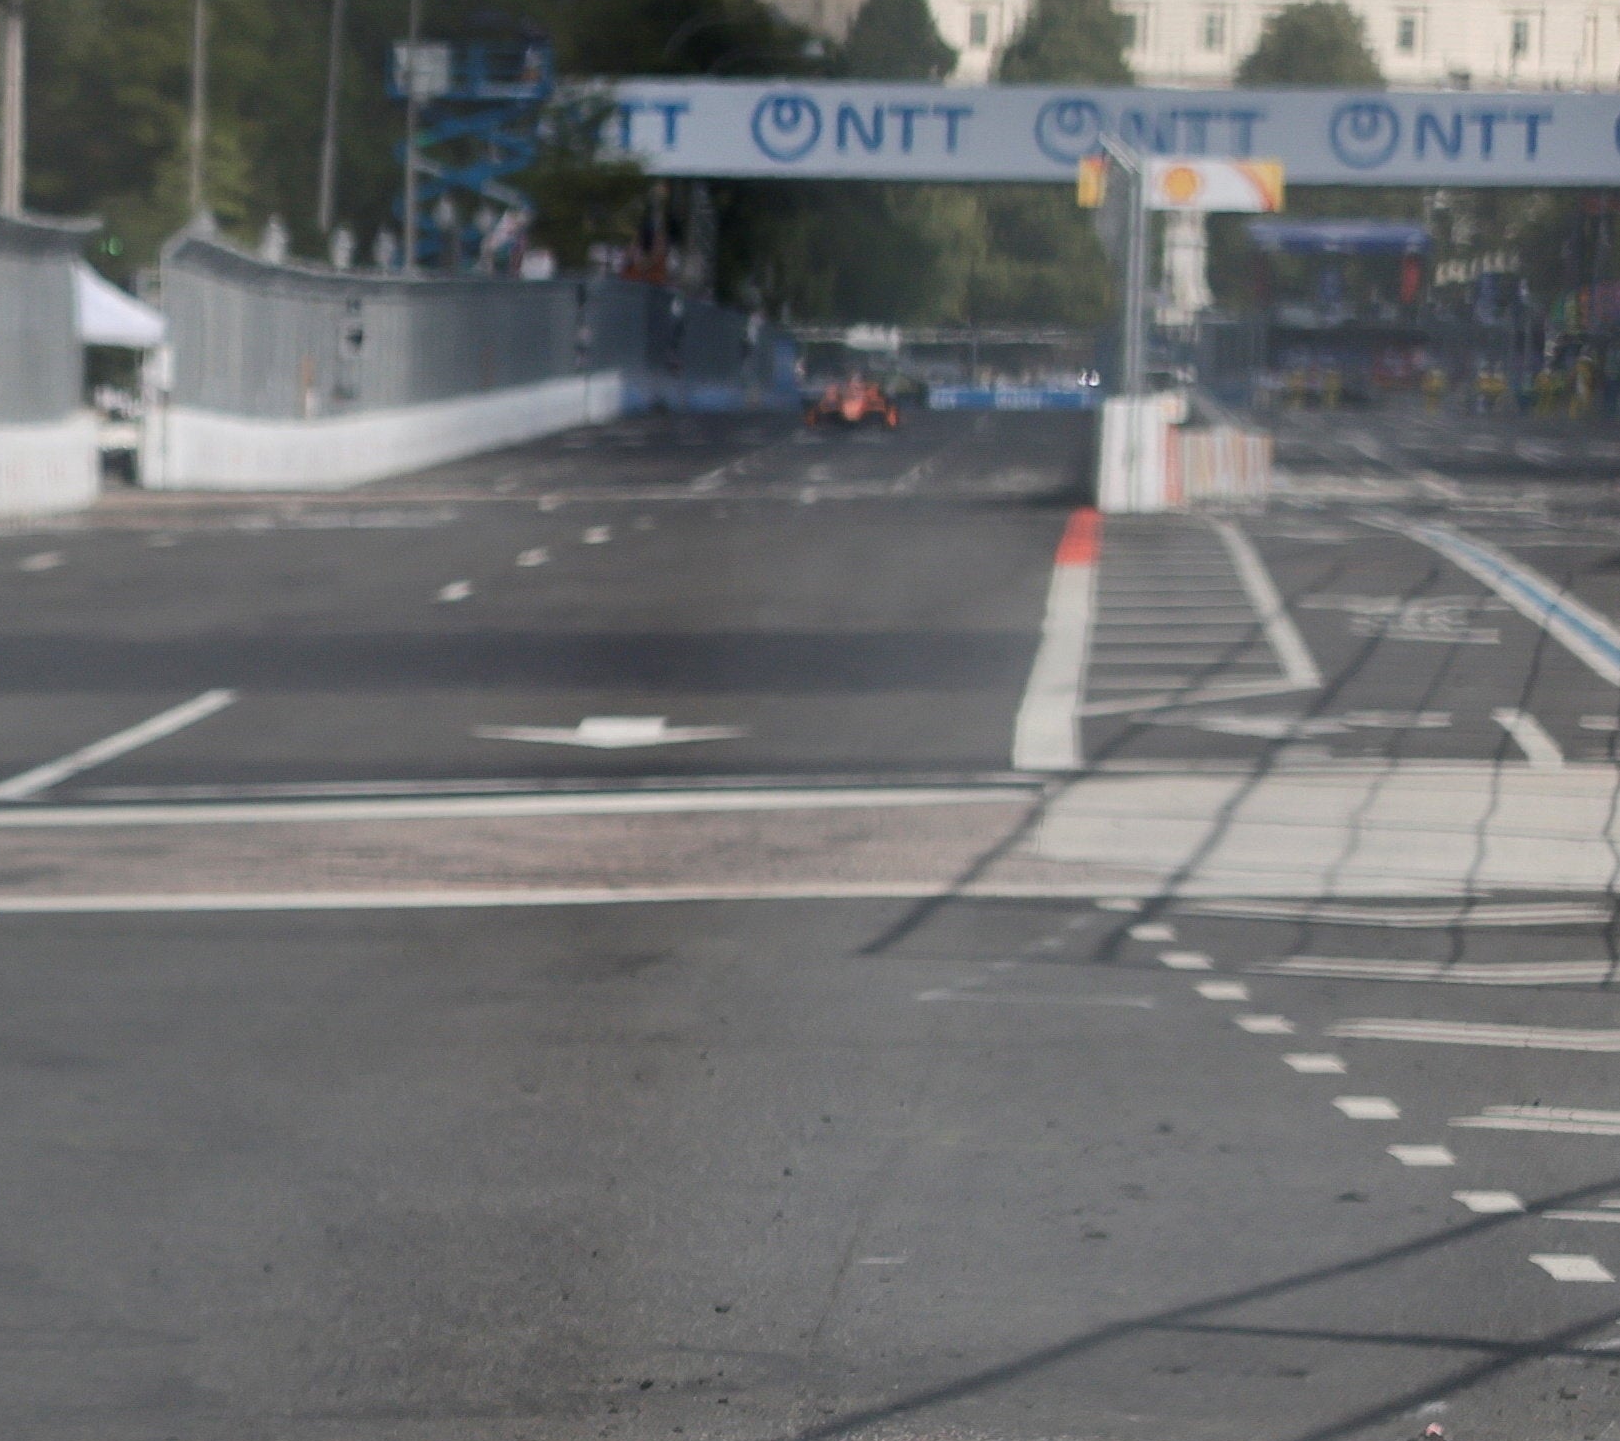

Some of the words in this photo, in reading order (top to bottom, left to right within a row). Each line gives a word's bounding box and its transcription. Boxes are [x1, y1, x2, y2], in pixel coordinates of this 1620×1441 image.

[836, 103, 974, 155] NTT
[1120, 108, 1266, 156] NTT
[1414, 106, 1553, 161] NTT
